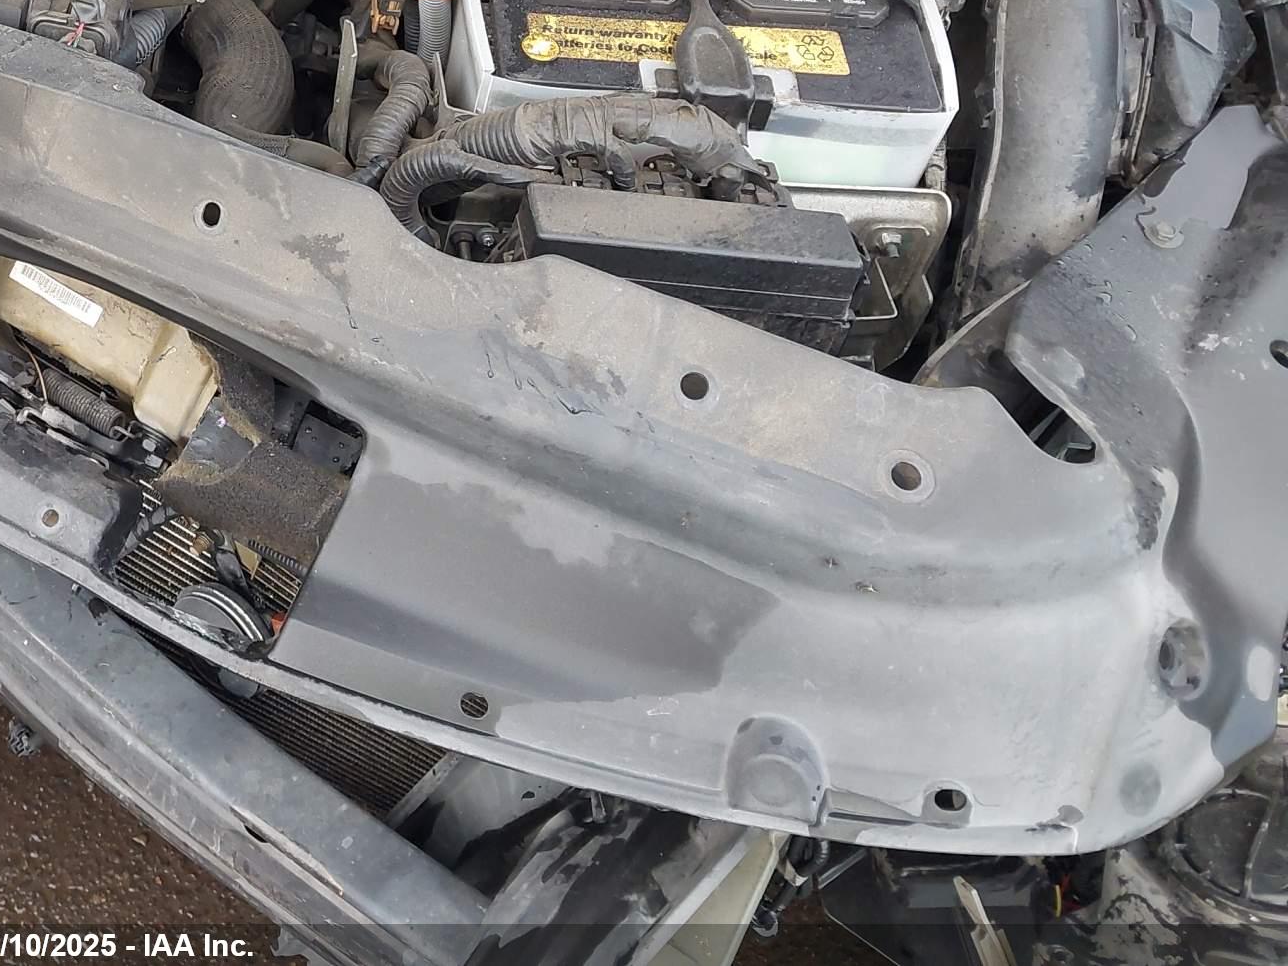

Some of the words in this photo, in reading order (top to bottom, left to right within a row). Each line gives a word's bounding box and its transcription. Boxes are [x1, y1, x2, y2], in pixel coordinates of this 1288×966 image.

[542, 24, 594, 36] Return
[600, 29, 668, 42] warranty
[557, 38, 612, 51] atteries
